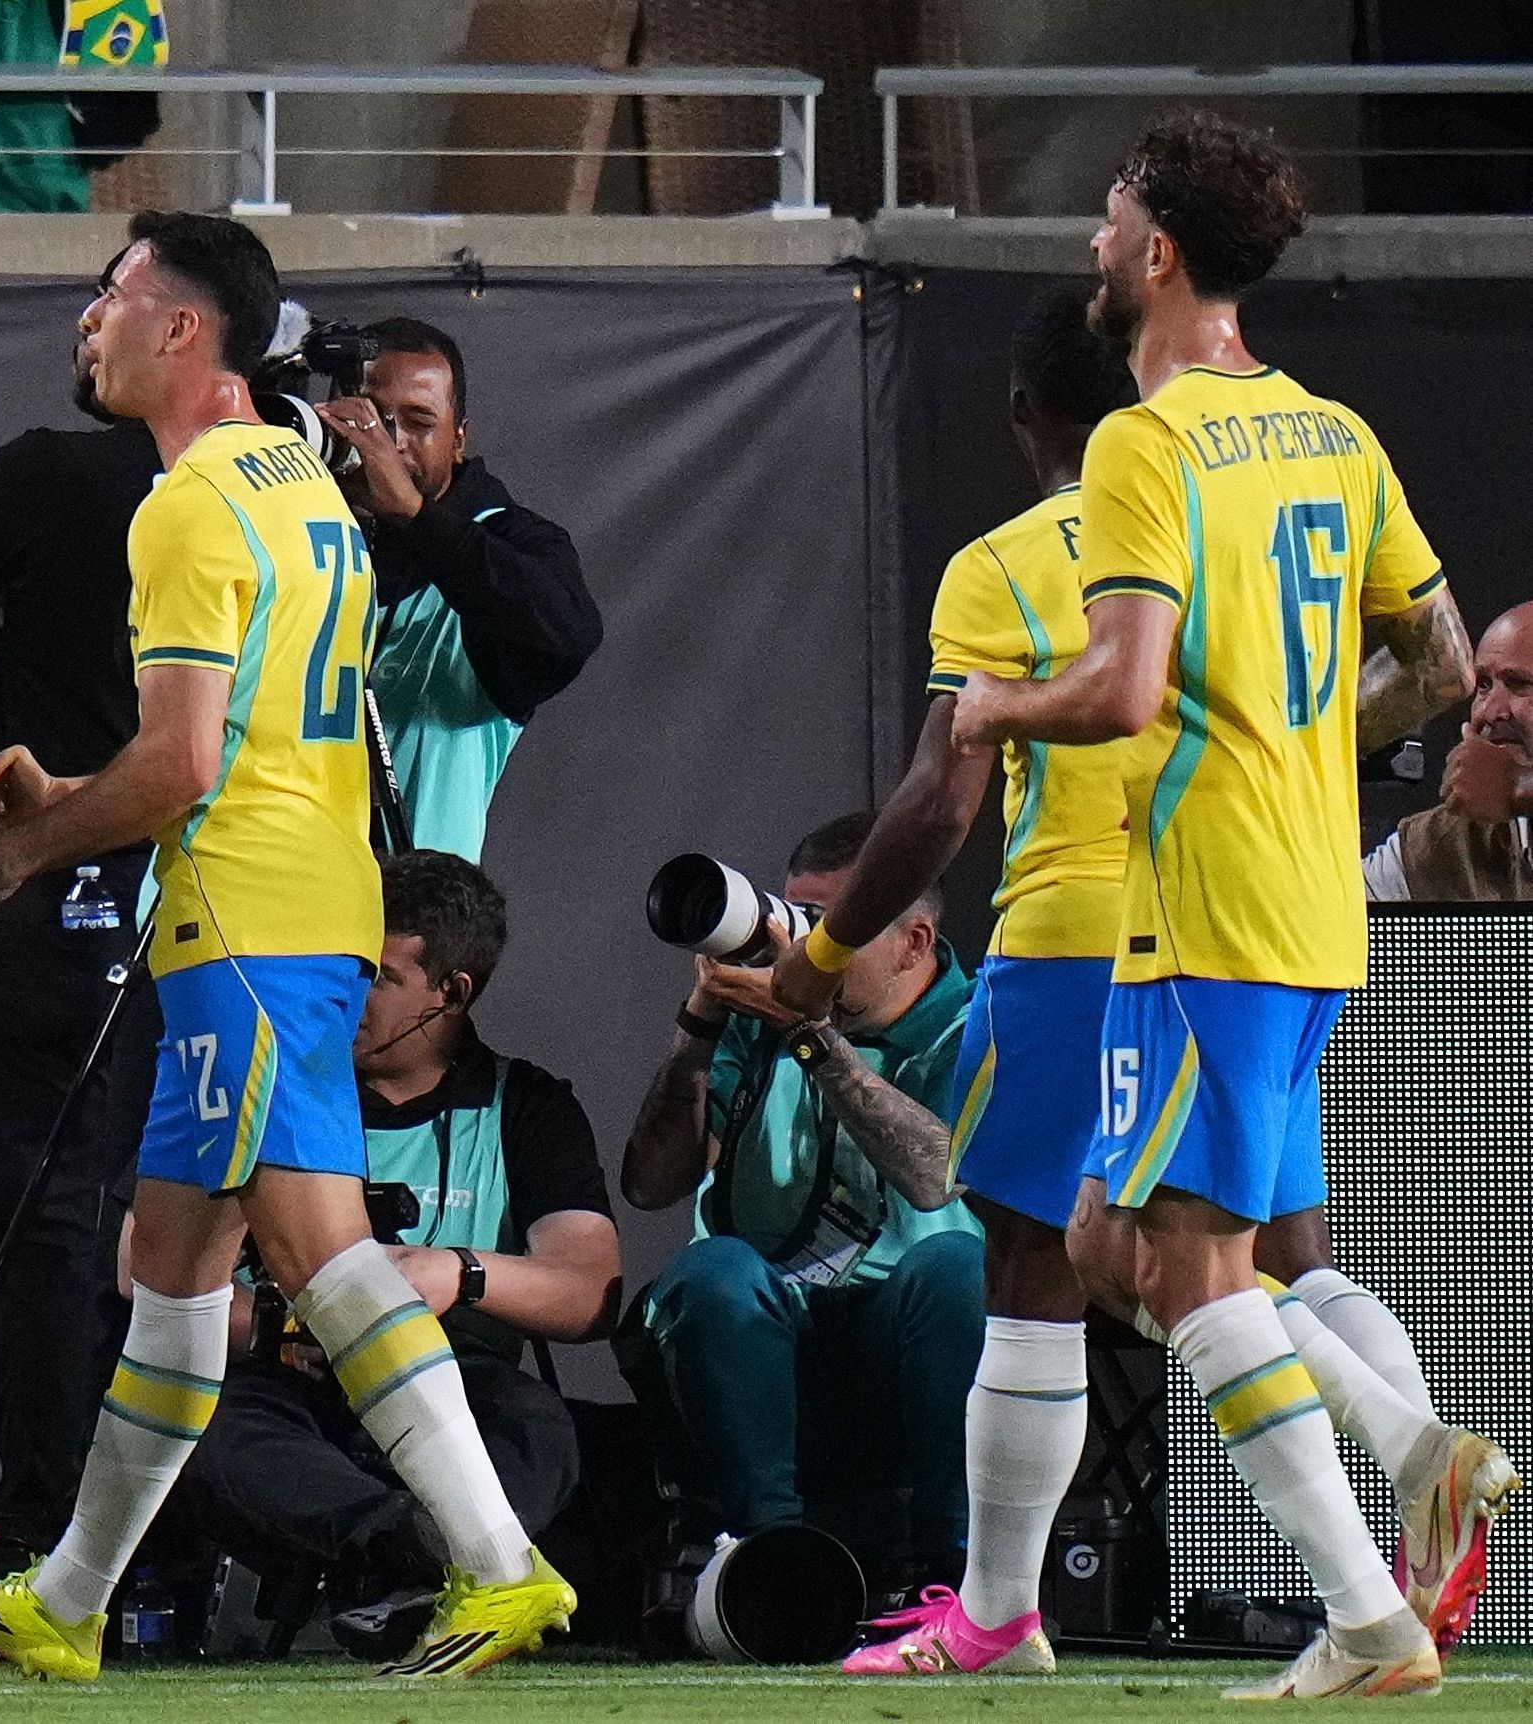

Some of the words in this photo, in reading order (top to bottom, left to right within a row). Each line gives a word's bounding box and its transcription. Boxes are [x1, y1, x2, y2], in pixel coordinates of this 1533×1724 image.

[1185, 412, 1252, 472] LÉO
[1250, 410, 1363, 462] PEREIRA
[1268, 500, 1349, 729] 15
[1101, 1047, 1141, 1138] 15
